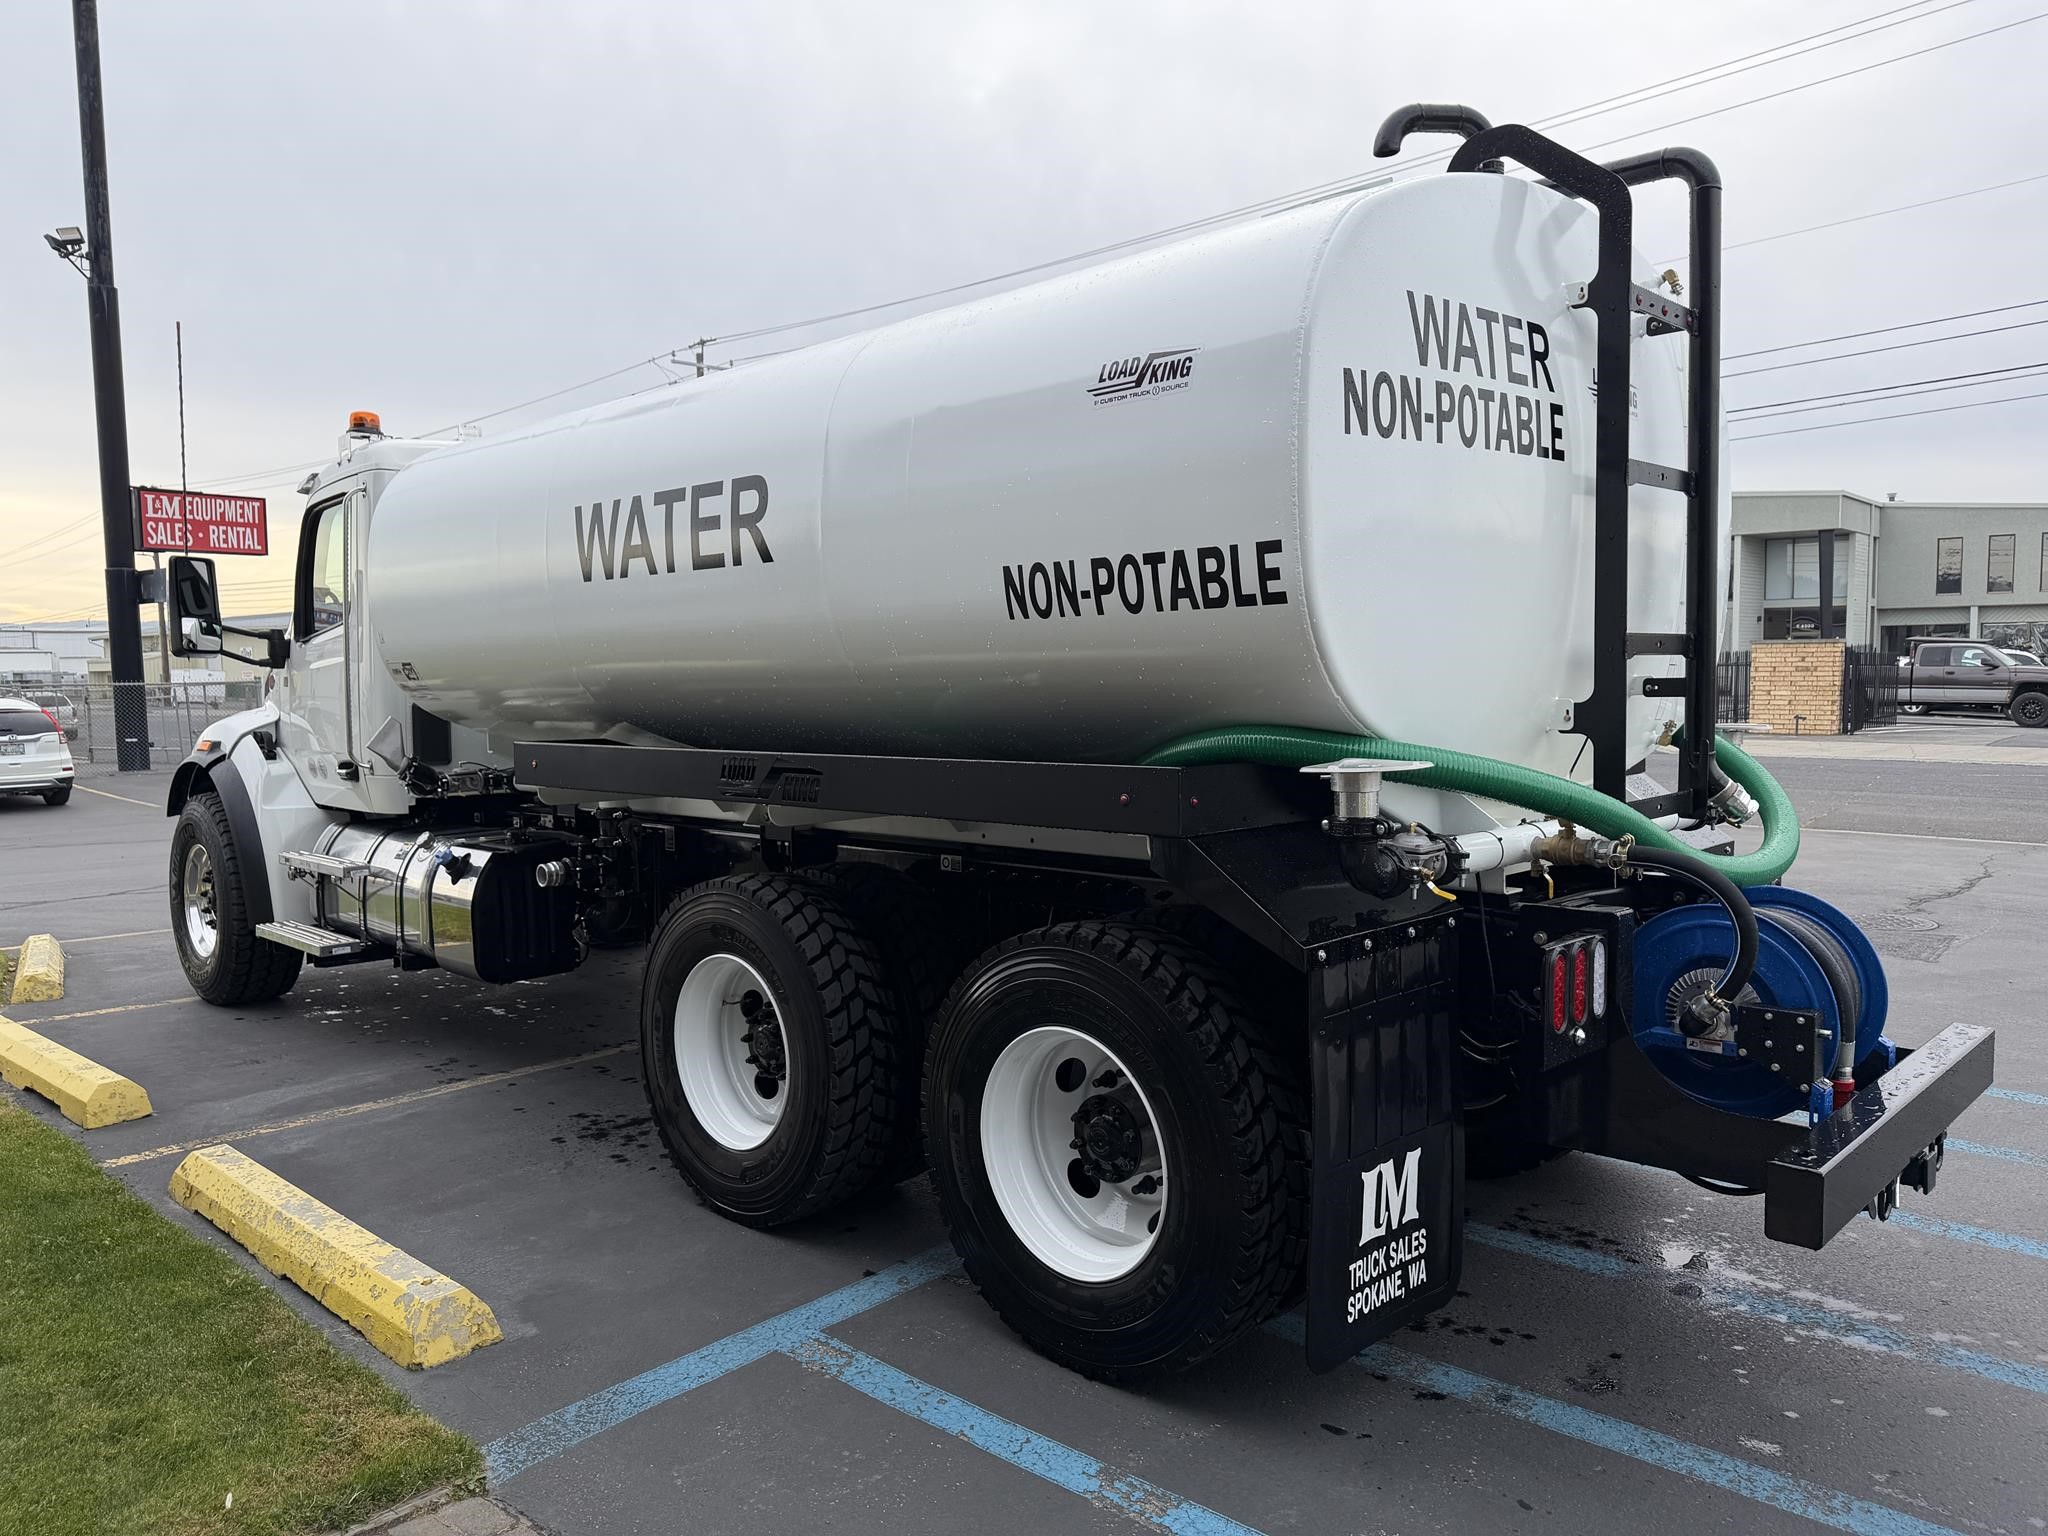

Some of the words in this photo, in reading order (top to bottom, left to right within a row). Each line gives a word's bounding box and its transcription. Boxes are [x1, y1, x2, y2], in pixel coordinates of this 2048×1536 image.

[1098, 357, 1141, 383] LOAD
[1148, 356, 1193, 385] KING
[1406, 290, 1555, 393] WATER
[1100, 394, 1128, 405] CUSTOM
[1129, 389, 1152, 399] TRUCK
[1161, 381, 1189, 393] SOURCE
[1343, 367, 1565, 462] NON-POTABLE
[144, 494, 182, 519] L&M
[185, 497, 260, 524] EQUIPMENT
[147, 521, 193, 547] SALES
[209, 525, 262, 550] RENTAL
[574, 474, 774, 583] WATER
[1002, 539, 1289, 620] NON-POTABLE
[1347, 1269, 1405, 1323] SPOKANE,
[1408, 1259, 1427, 1289] WA
[1349, 1245, 1387, 1291] TRUCK
[1389, 1228, 1427, 1268] SALES
